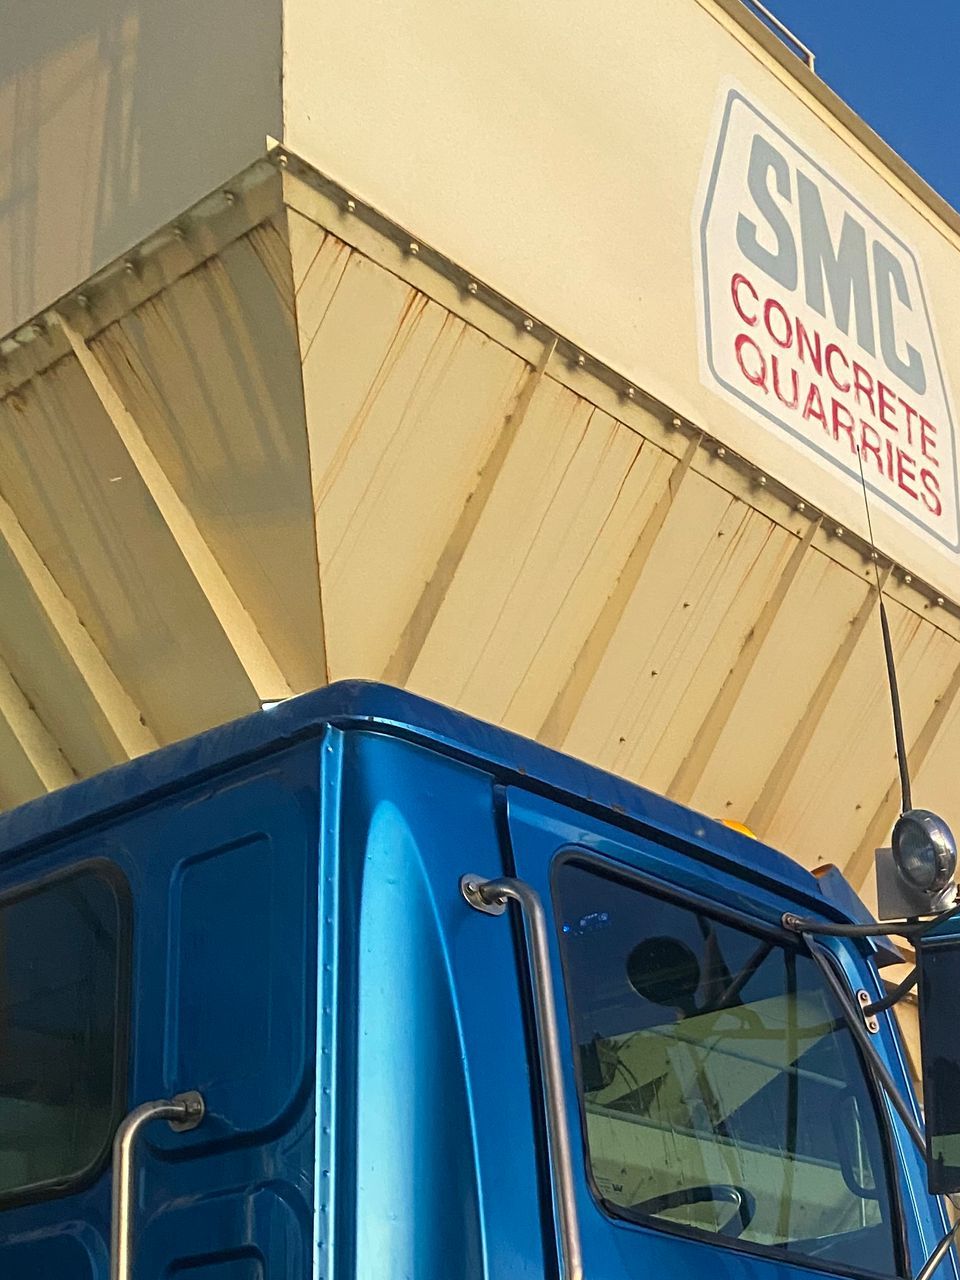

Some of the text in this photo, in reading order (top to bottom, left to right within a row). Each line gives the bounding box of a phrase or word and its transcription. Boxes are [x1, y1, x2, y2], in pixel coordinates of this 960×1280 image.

[736, 134, 926, 396] SMC
[730, 272, 940, 467] CONCRETE
[733, 332, 942, 518] QUARRIES
